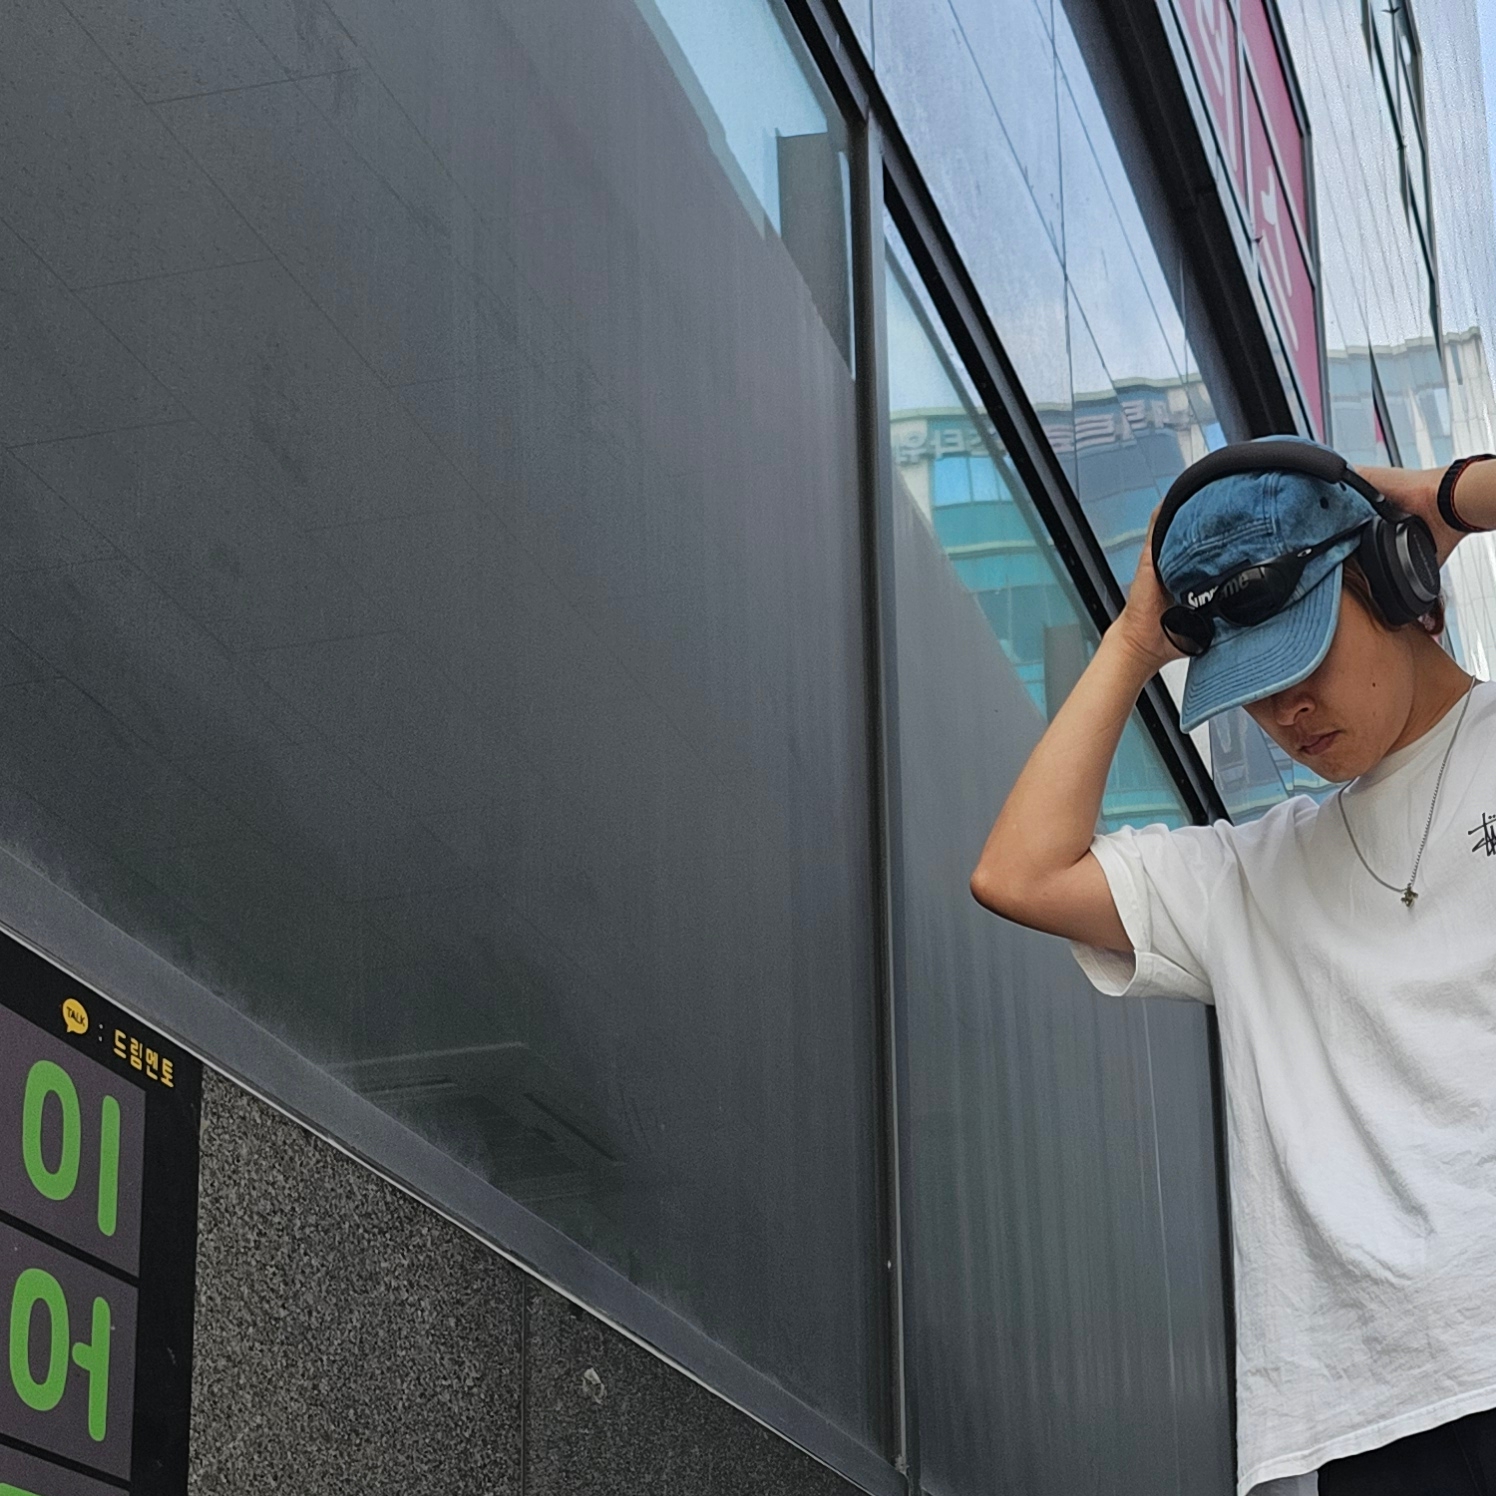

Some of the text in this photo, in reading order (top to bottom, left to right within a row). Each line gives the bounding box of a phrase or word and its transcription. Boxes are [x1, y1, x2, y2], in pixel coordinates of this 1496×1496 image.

[66, 1006, 86, 1027] TALK
[114, 1029, 174, 1088] 드림멘토
[22, 1060, 120, 1237] 이
[10, 1268, 111, 1442] 어
